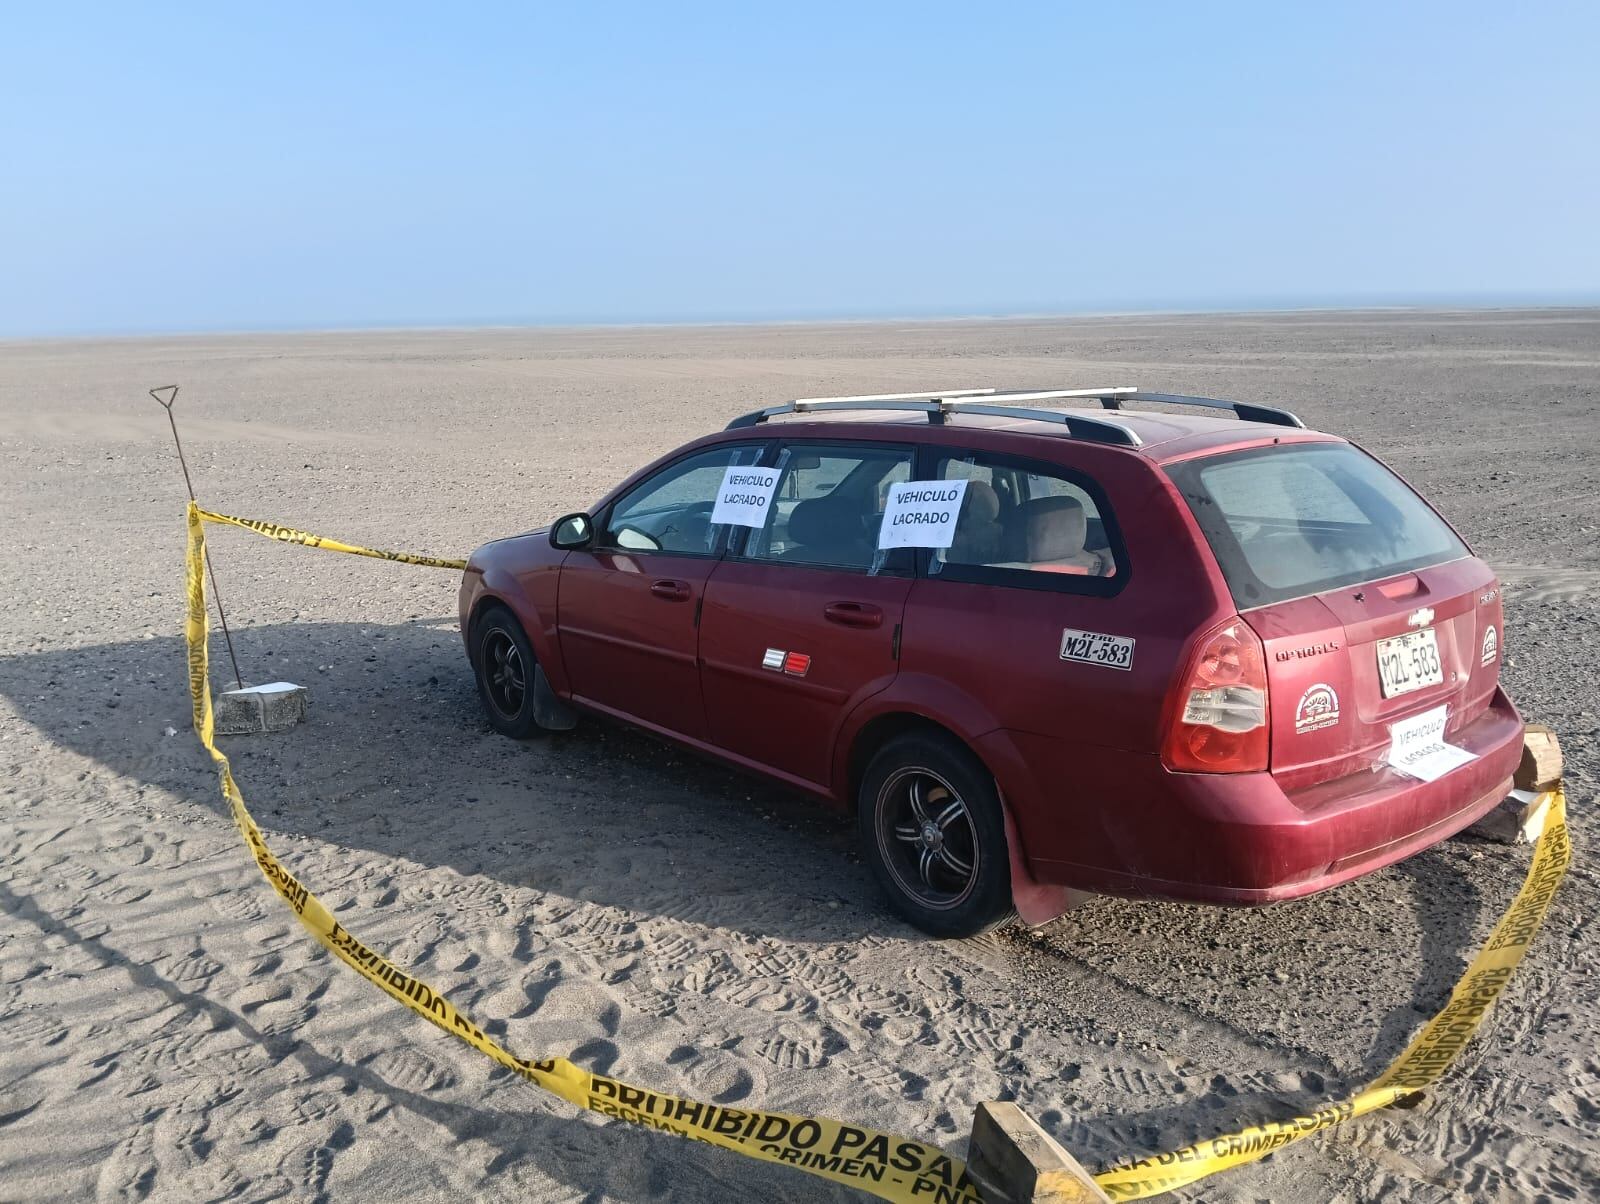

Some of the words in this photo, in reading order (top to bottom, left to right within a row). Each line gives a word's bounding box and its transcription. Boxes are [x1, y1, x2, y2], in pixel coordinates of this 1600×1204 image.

[729, 475, 773, 488] VEHICULO
[724, 494, 766, 507] LACRADO
[897, 490, 958, 504] VEHICULO
[893, 512, 950, 526] LACRADO
[1082, 633, 1115, 642] PERU
[1063, 637, 1130, 663] M2L-583
[1382, 644, 1438, 687] M2L-583
[1400, 719, 1443, 746] VEHICULO
[1399, 743, 1446, 765] LACRADO
[591, 1078, 822, 1149] PROHIBIDO
[760, 1144, 886, 1182] CRIMEN
